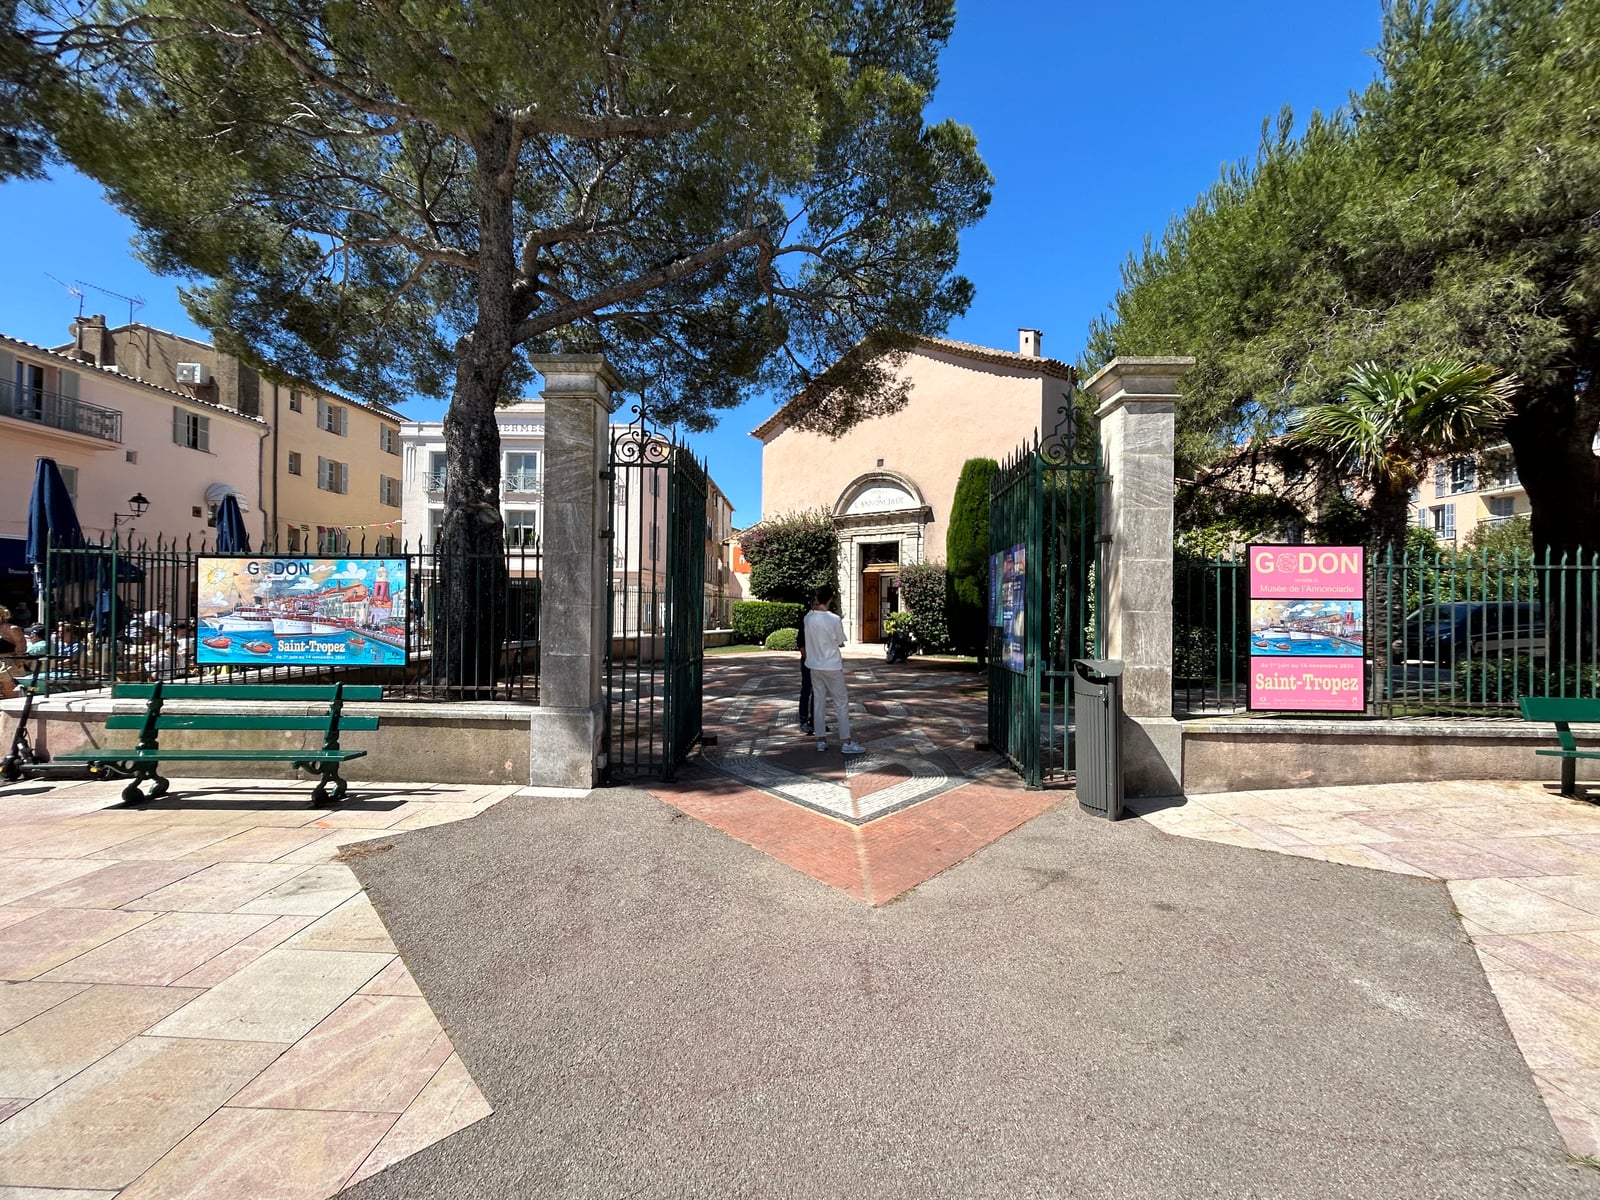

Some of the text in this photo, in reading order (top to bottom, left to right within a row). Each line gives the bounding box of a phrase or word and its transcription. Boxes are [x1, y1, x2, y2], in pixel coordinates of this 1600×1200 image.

[247, 561, 310, 576] GODON
[1255, 552, 1359, 575] GODON
[1260, 584, 1354, 593] Musée de l'Annonciade
[277, 639, 346, 655] Saint-Tropez
[1255, 672, 1359, 695] Saint-Tropez
